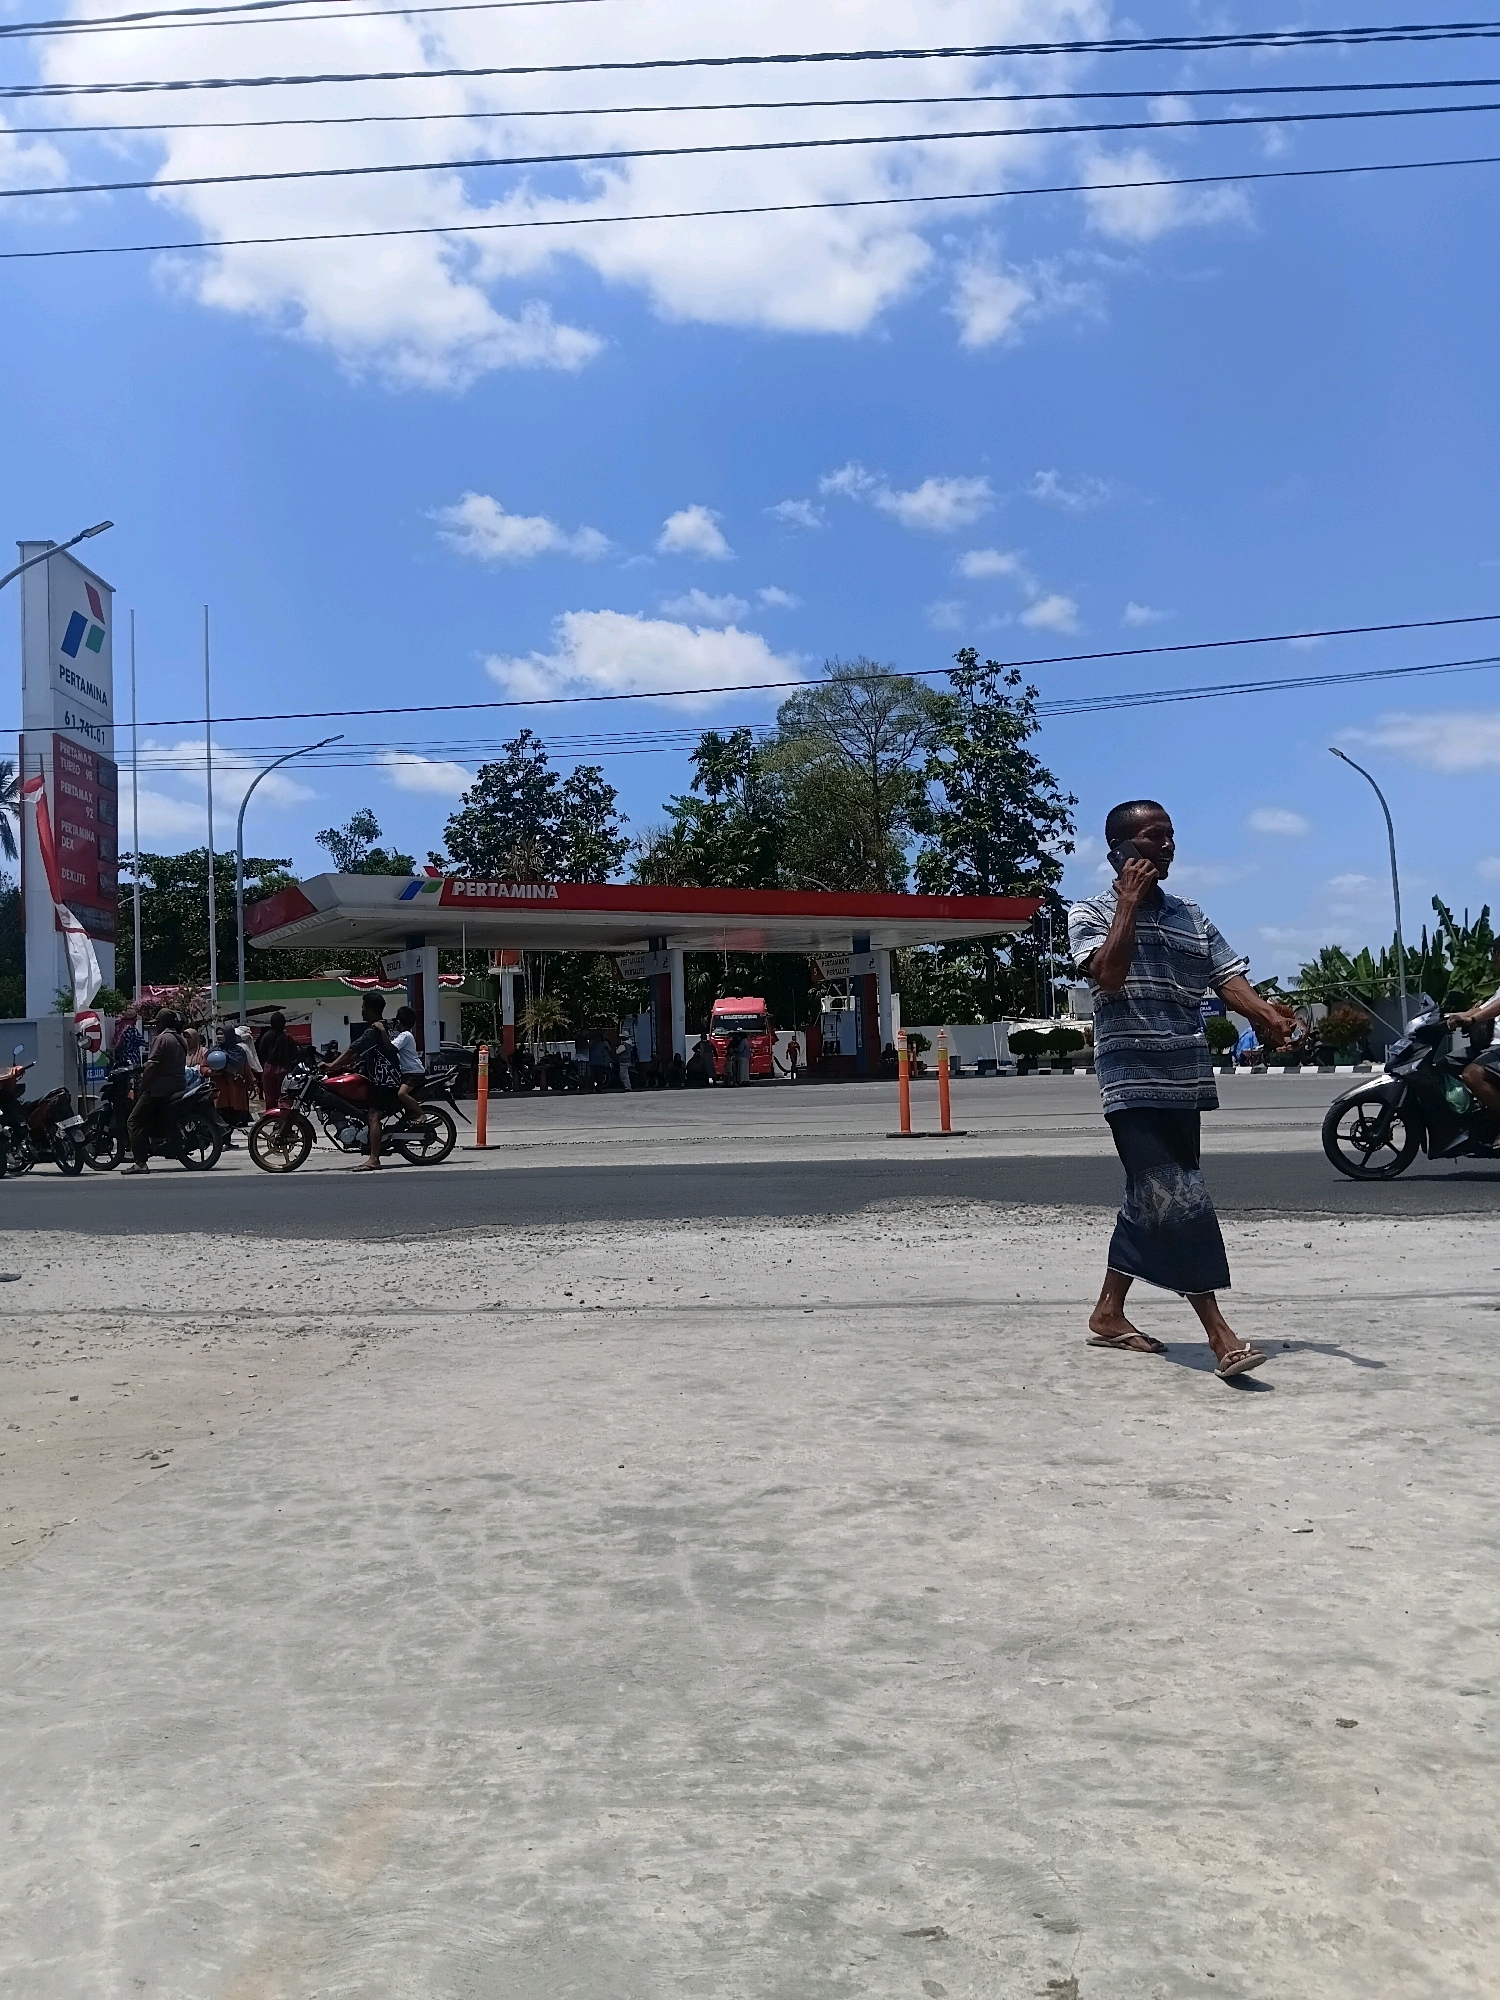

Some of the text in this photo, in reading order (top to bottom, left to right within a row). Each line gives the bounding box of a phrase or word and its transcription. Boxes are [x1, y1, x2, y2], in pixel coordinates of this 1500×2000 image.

[59, 664, 108, 707] PERTAMINA
[60, 742, 93, 767] PERTAMAX
[61, 757, 80, 776] TURBO
[60, 780, 94, 804] PERTAMAX
[61, 820, 96, 843] PERTAMINA
[61, 836, 75, 851] DEX
[61, 867, 86, 885] DEXLITE
[451, 881, 559, 899] PERTAMINA
